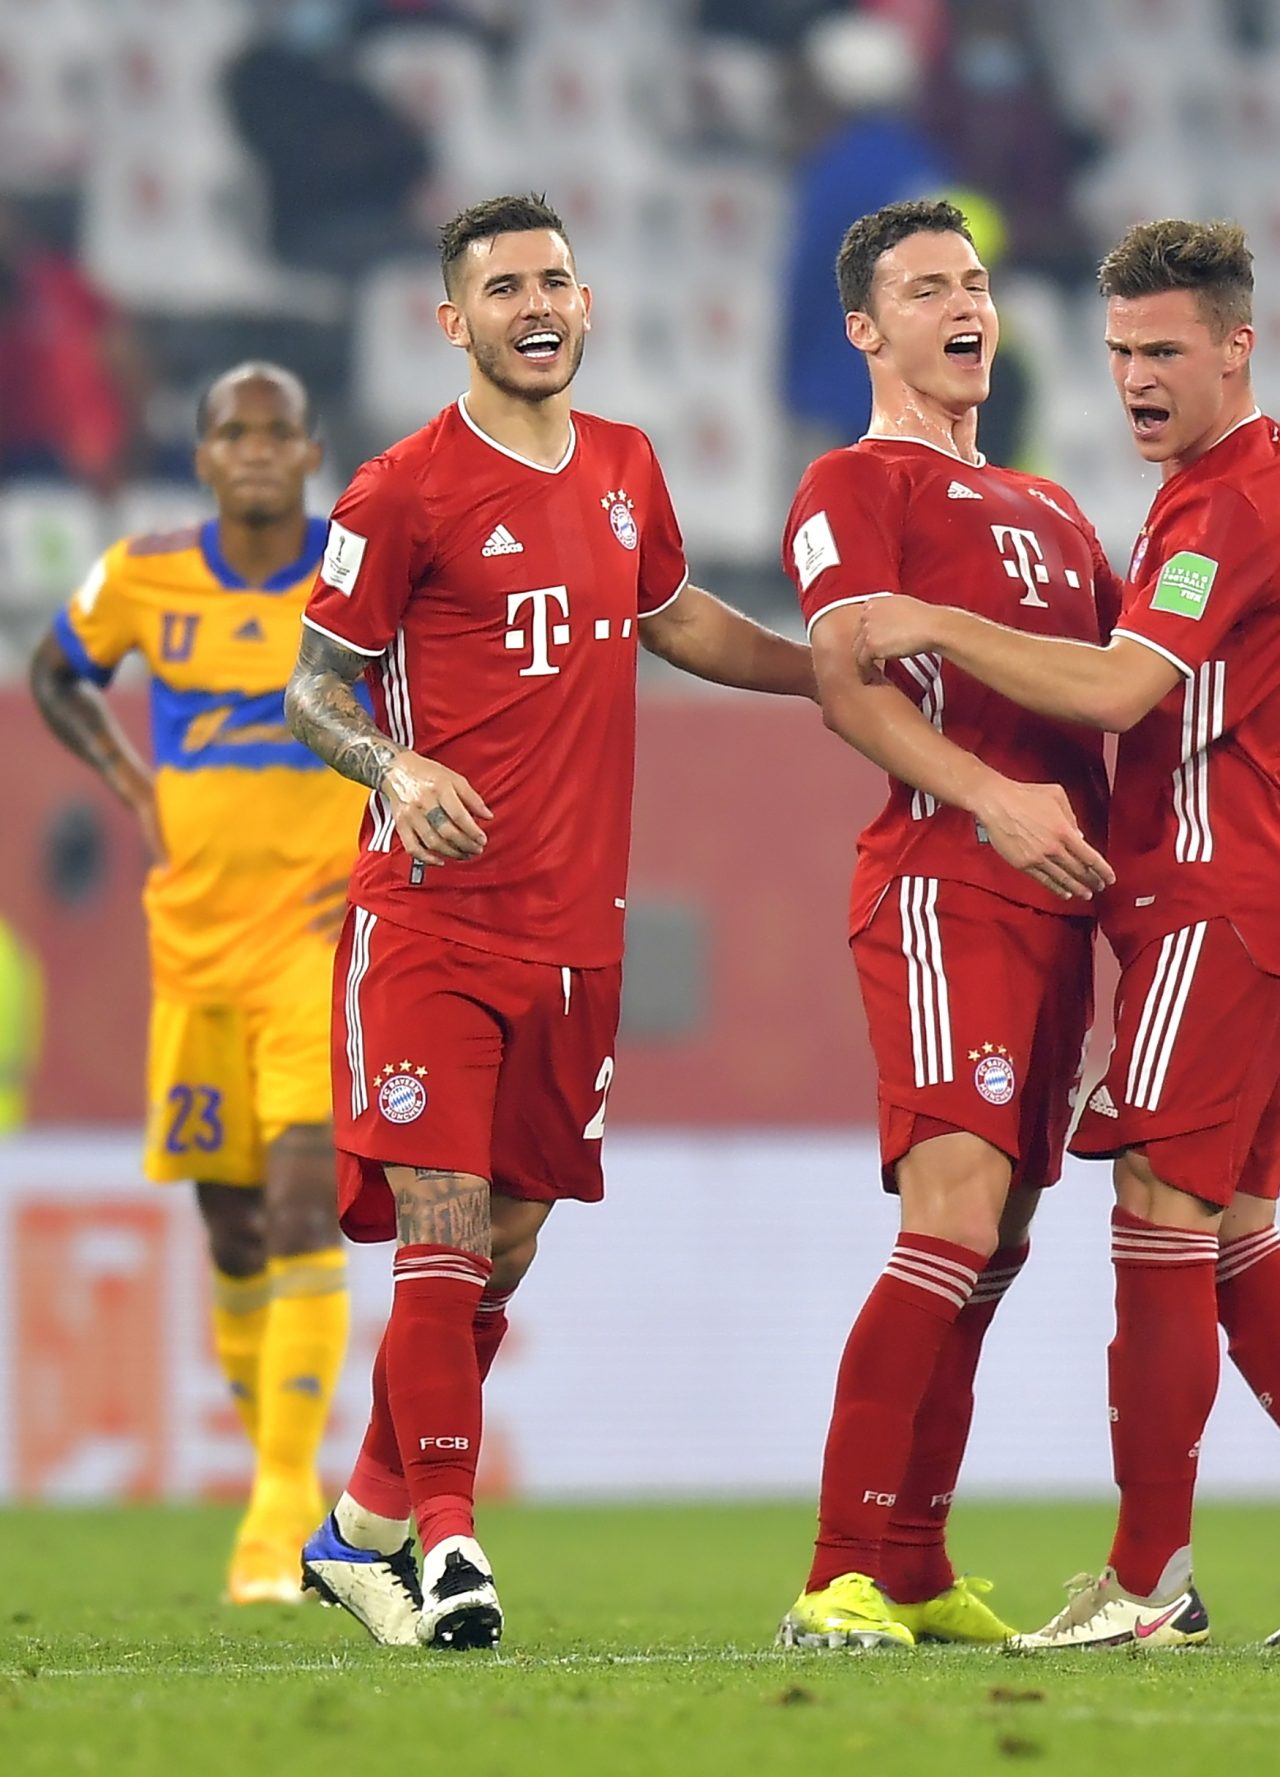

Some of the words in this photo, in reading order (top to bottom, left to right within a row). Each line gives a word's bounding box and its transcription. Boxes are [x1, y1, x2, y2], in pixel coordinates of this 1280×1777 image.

[482, 542, 524, 557] adidas
[1163, 573, 1206, 590] FOOTBALL
[1165, 566, 1209, 583] LIVING
[166, 1084, 224, 1154] 23
[420, 1436, 469, 1450] FCB
[862, 1490, 896, 1507] FCB
[930, 1491, 954, 1507] FC
